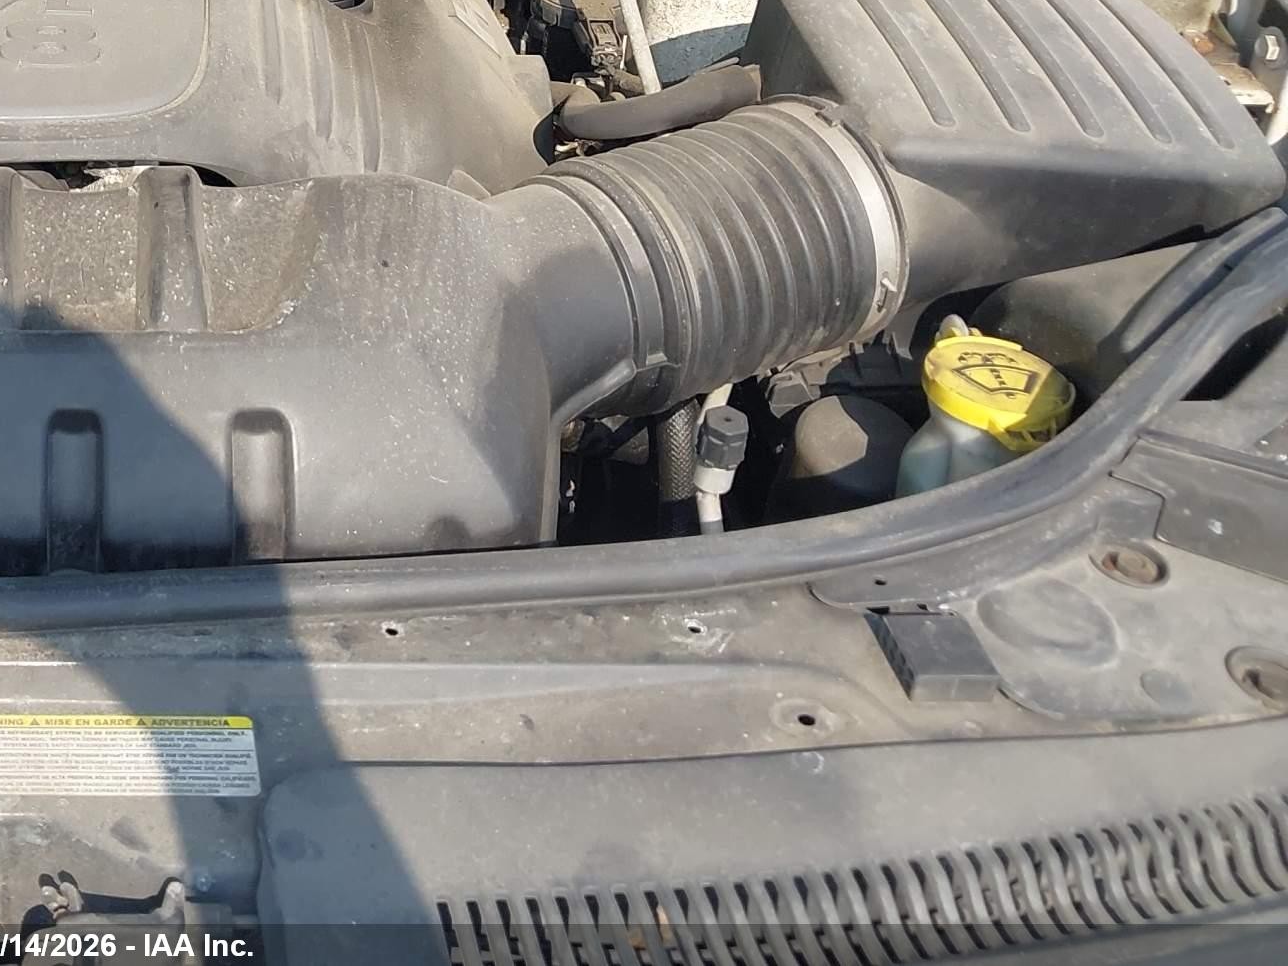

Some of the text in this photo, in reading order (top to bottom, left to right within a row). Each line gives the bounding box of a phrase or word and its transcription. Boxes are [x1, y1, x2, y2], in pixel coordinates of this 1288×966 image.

[44, 718, 72, 726] MISE
[75, 718, 90, 726] EN
[93, 718, 132, 726] GARDE
[151, 718, 230, 727] ADVERTENCIA
